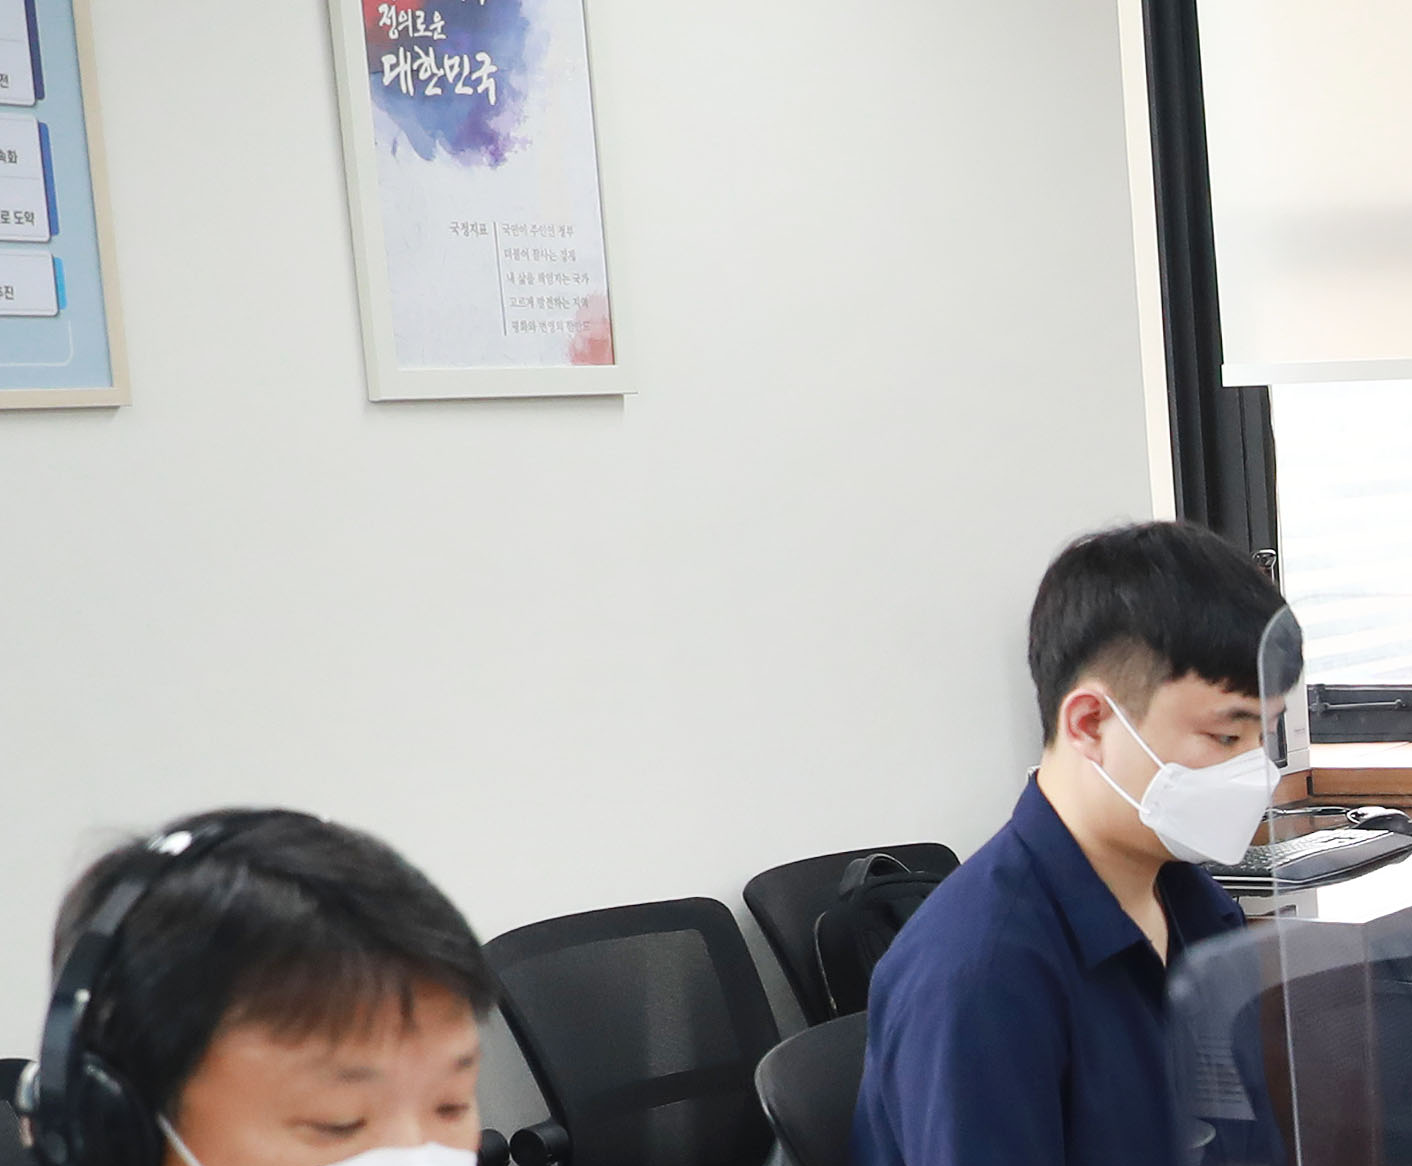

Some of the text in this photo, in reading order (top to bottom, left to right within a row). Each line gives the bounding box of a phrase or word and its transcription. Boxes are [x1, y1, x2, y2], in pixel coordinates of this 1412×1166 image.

[378, 3, 446, 40] 정의로운
[381, 46, 498, 105] 대한민국
[13, 210, 35, 226] 도약
